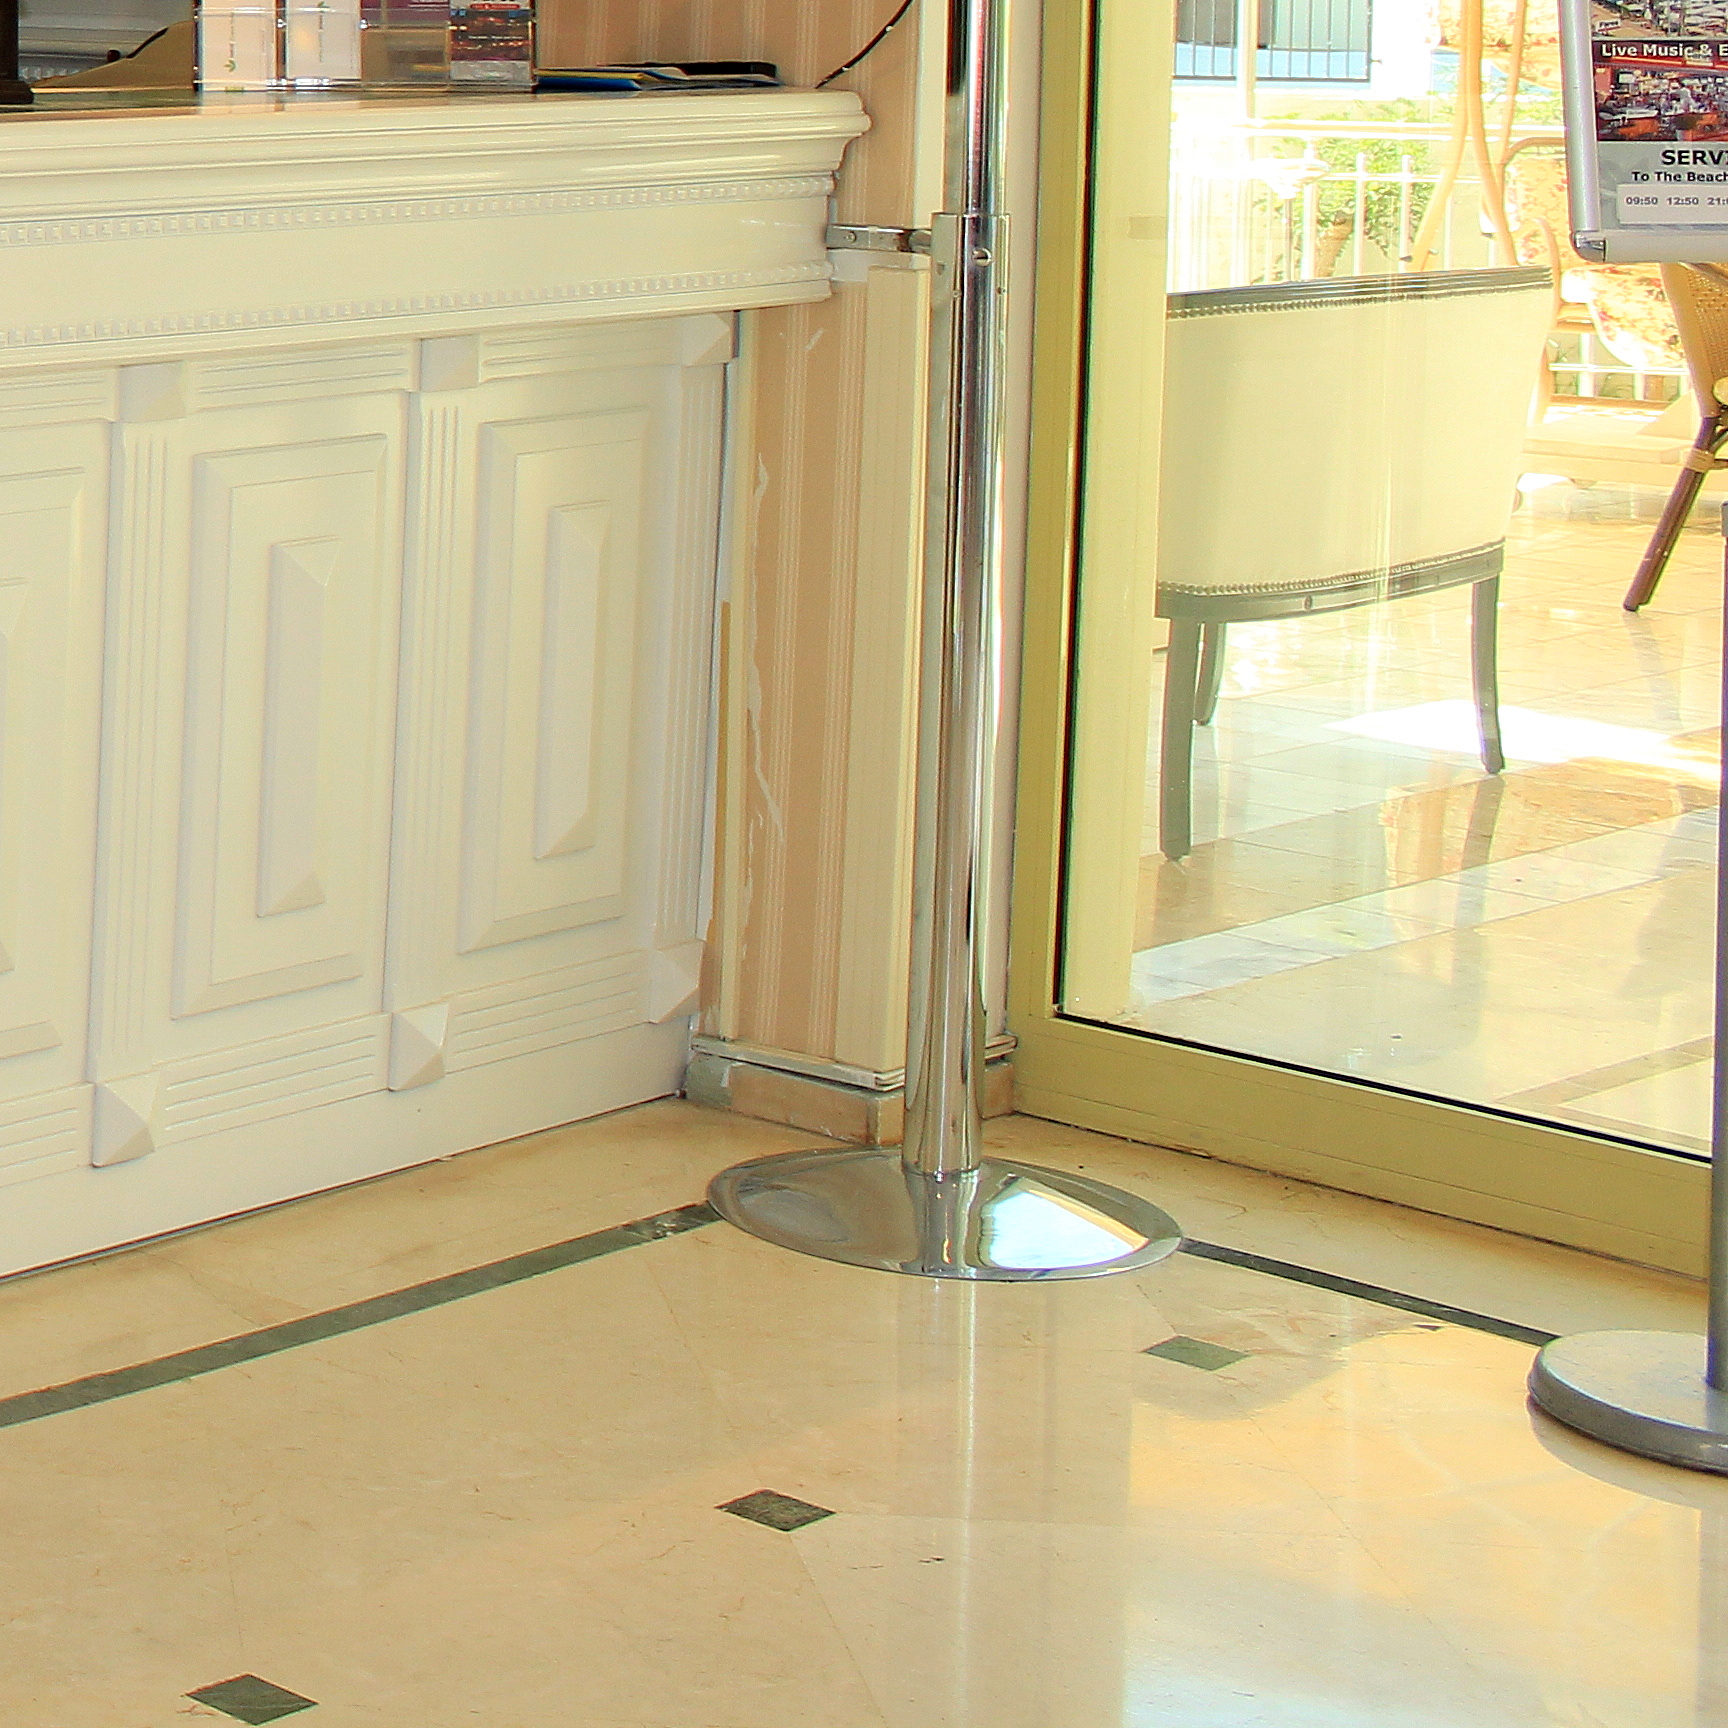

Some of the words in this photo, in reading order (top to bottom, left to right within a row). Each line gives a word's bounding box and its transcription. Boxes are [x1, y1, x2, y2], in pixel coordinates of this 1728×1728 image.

[1601, 43, 1638, 57] Live
[1643, 42, 1694, 57] Music
[1699, 43, 1712, 57] &
[1631, 171, 1650, 182] To
[1654, 171, 1682, 182] The
[1625, 196, 1659, 206] 09:50
[1666, 196, 1699, 206] 12:50
